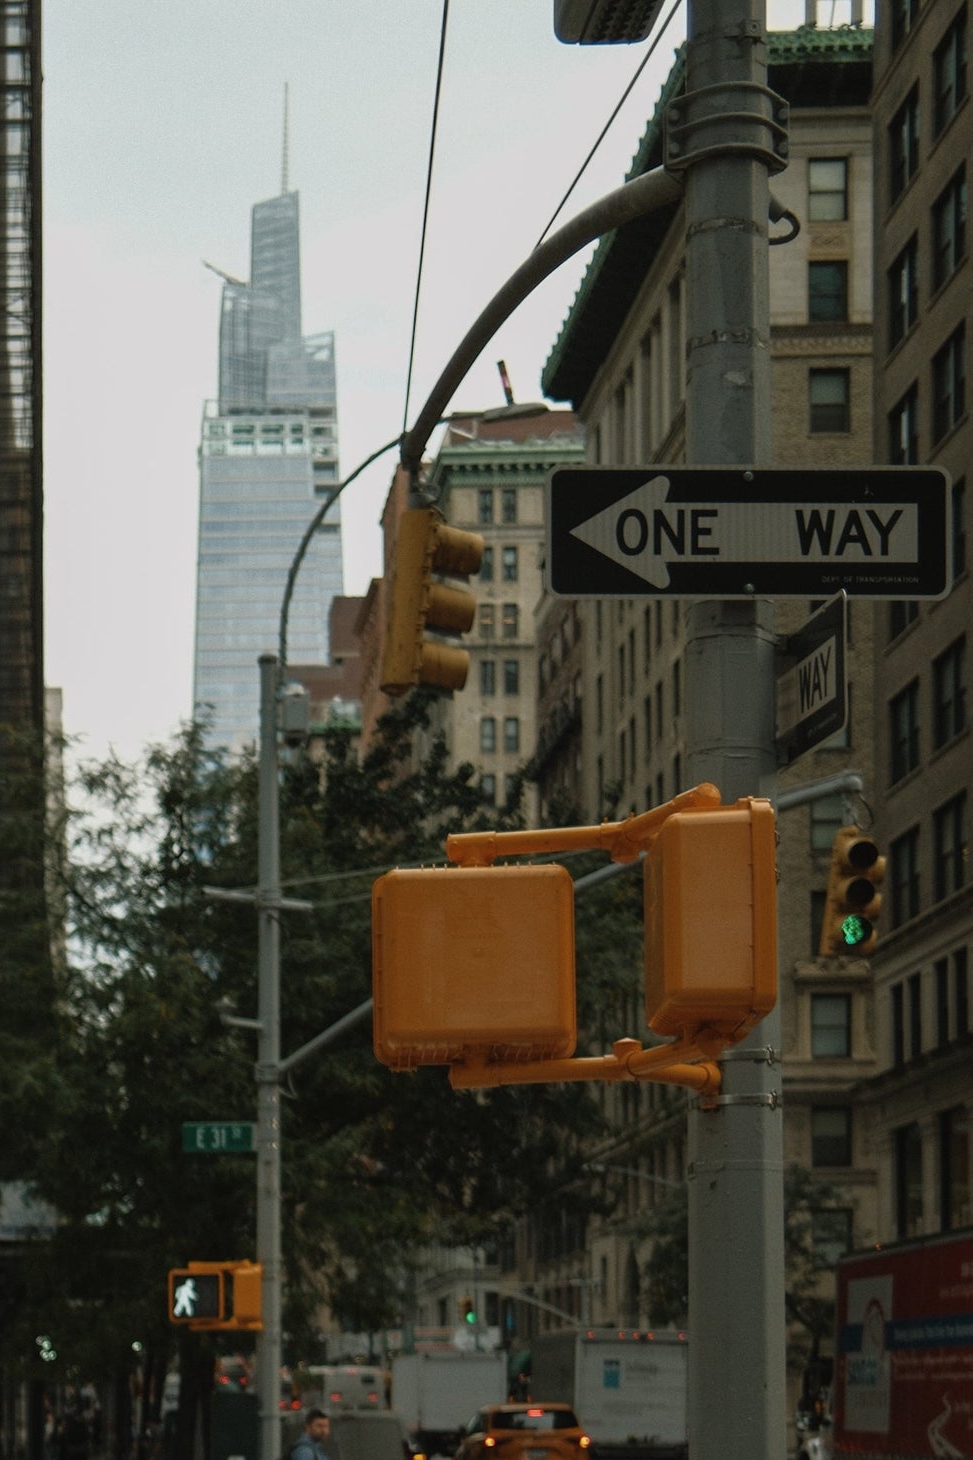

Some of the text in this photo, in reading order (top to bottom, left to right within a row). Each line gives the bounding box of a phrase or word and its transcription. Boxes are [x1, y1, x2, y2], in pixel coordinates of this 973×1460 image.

[615, 508, 904, 557] ONE WAY
[856, 576, 920, 584] TRANSPORTATION
[799, 646, 831, 714] WAY
[196, 1127, 205, 1148] E
[211, 1126, 227, 1148] 31
